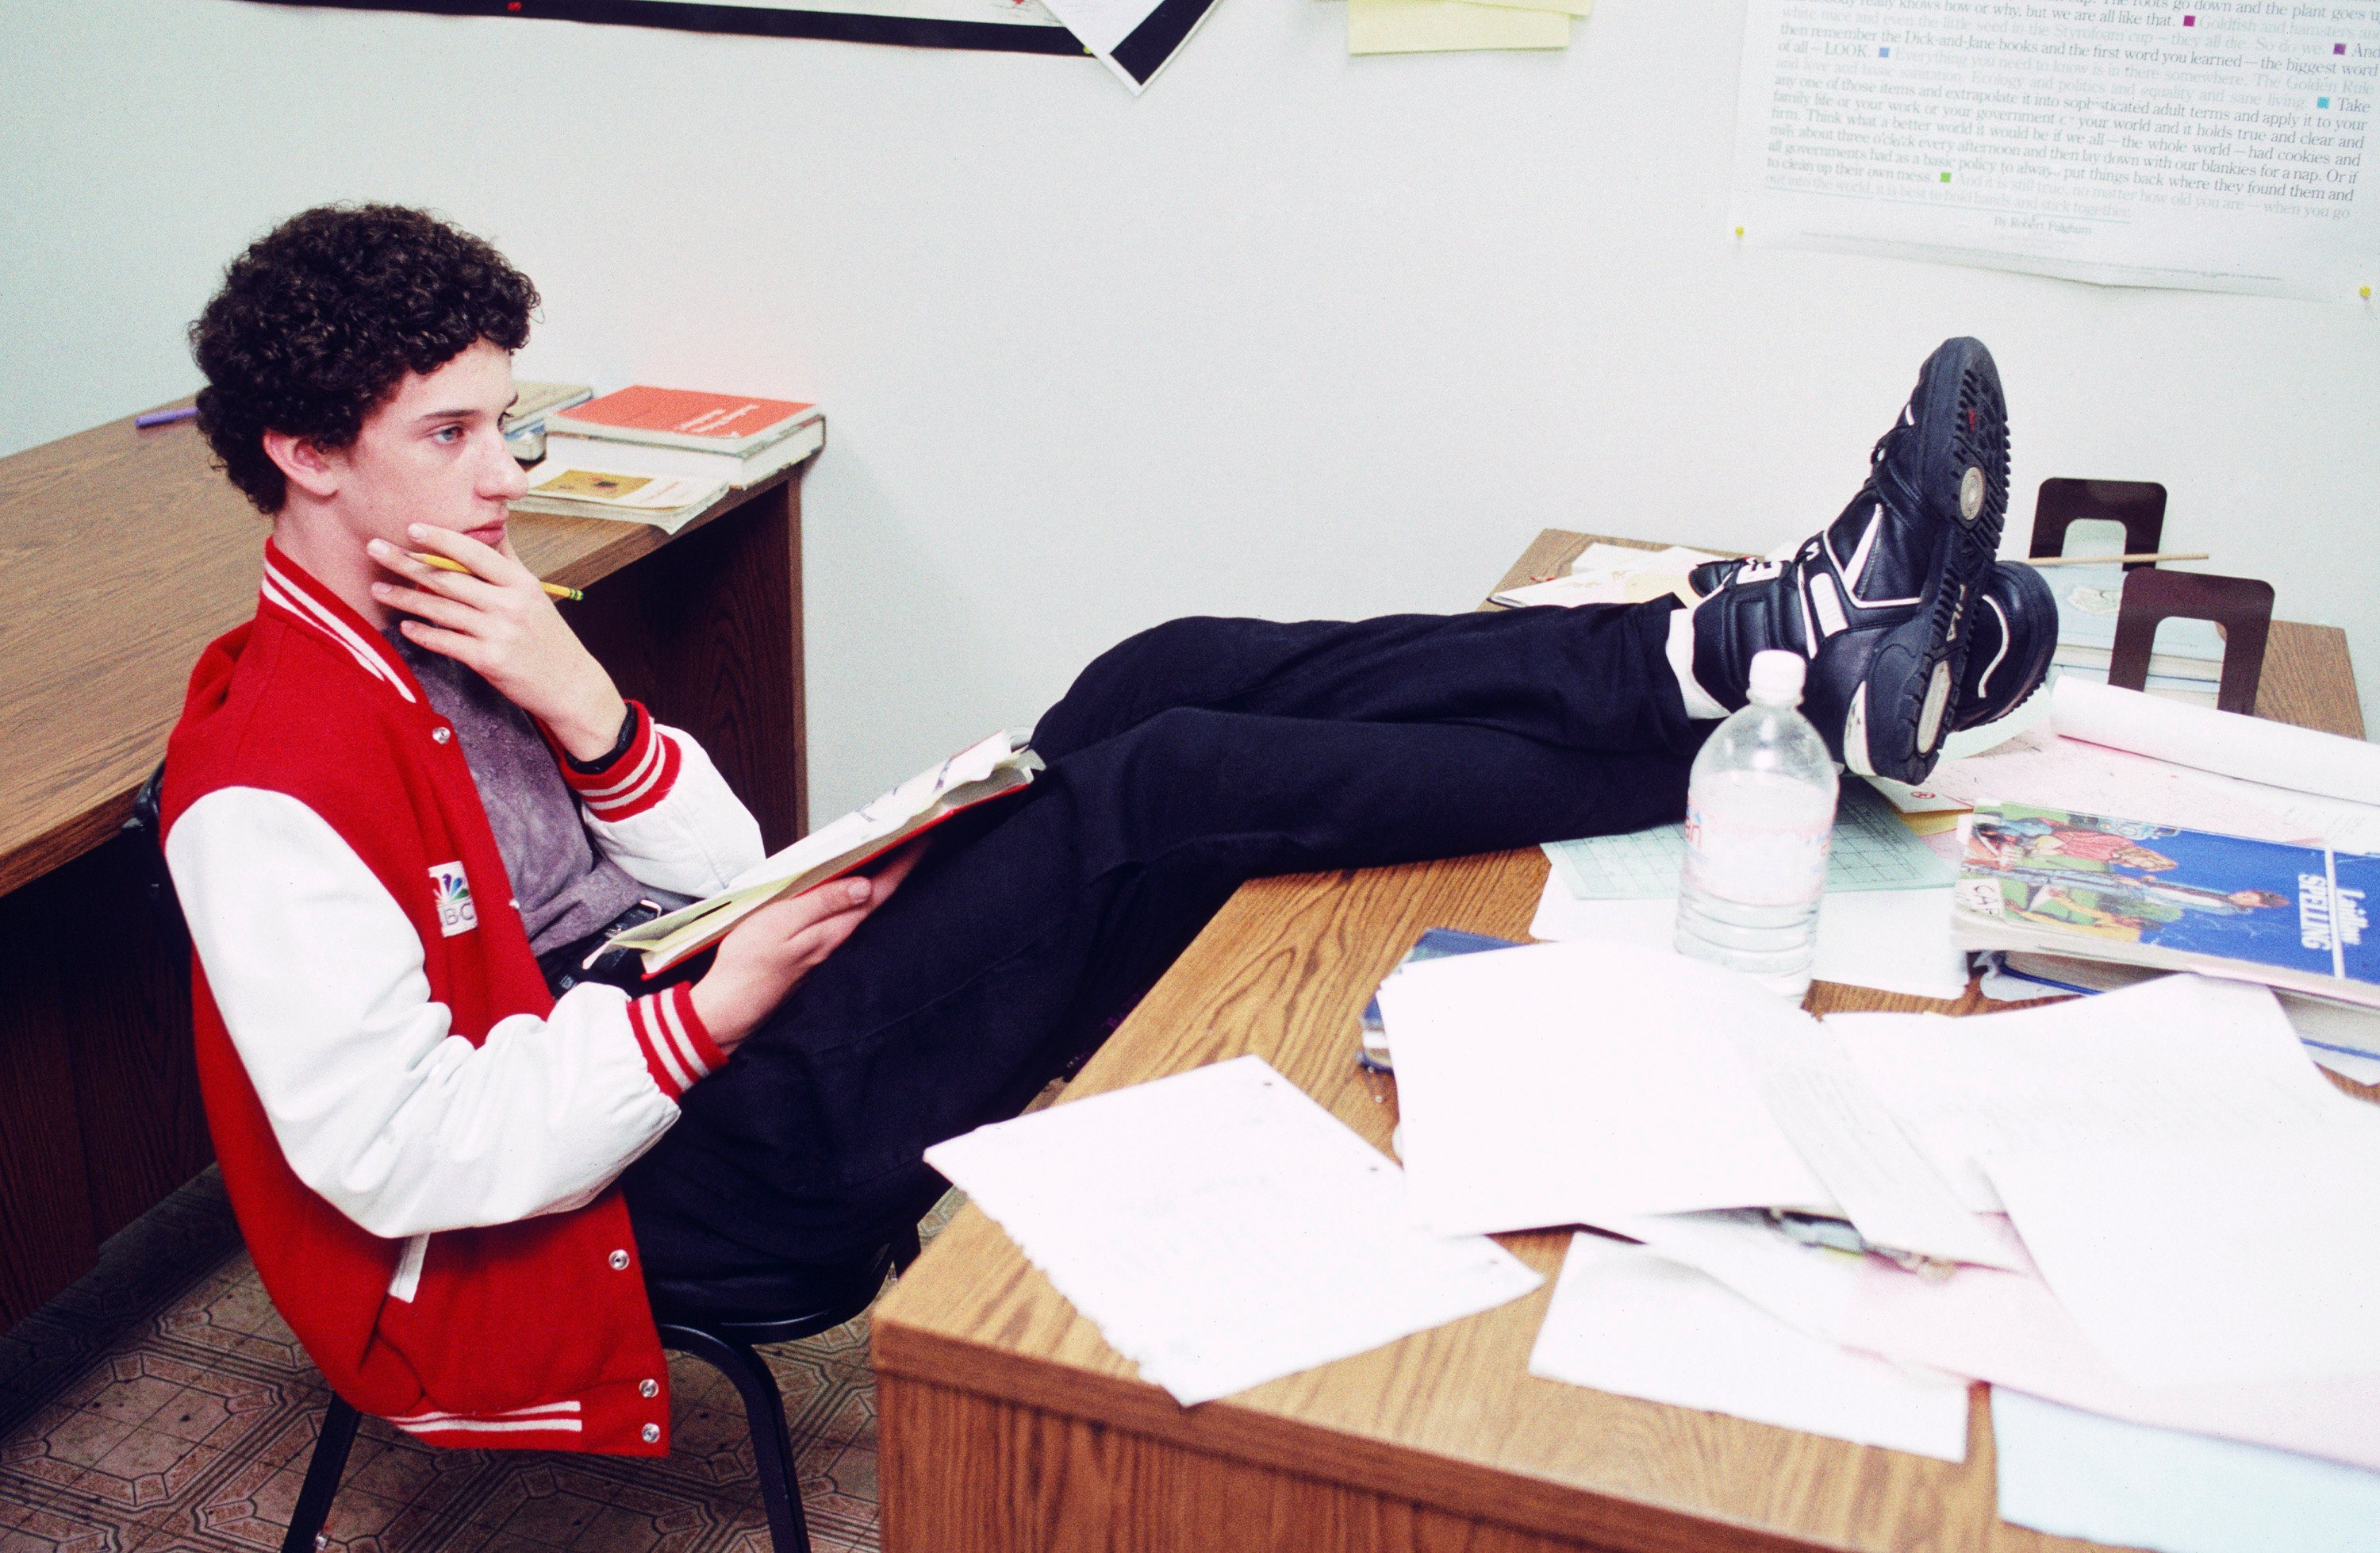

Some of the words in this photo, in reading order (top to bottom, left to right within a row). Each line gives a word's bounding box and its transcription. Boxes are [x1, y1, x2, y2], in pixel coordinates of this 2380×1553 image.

[1898, 0, 1940, 10] knows
[1944, 0, 1971, 13] how
[1974, 3, 1989, 14] or
[2025, 2, 2047, 18] but
[2052, 9, 2071, 20] we
[2074, 10, 2097, 21] are
[2098, 8, 2115, 22] all
[2117, 8, 2143, 25] like
[2171, 0, 2190, 13] go
[2194, 0, 2232, 12] down
[2235, 0, 2262, 13] and
[2265, 0, 2288, 16] the
[2291, 2, 2327, 21] plant
[2330, 8, 2367, 23] goes
[1779, 21, 1808, 37] then
[1811, 26, 1878, 41] remember
[1880, 29, 1901, 44] the
[1998, 37, 2038, 54] books
[2040, 40, 2066, 56] and
[2067, 42, 2090, 57] the
[2093, 43, 2121, 60] first
[2124, 47, 2159, 62] word
[2160, 52, 2186, 67] you
[2286, 56, 2338, 76] biggest
[2340, 61, 2379, 76] word
[1774, 75, 1795, 90] any
[1799, 77, 1821, 88] one
[1825, 75, 1839, 90] of
[1841, 77, 1875, 92] those
[1879, 80, 1915, 96] items
[1918, 84, 1942, 98] and
[1944, 88, 2018, 106] extrapolate
[2021, 91, 2032, 106] it
[2034, 92, 2059, 107] into
[2152, 101, 2186, 117] adult
[2190, 105, 2231, 121] terms
[2233, 107, 2259, 122] and
[2262, 110, 2299, 129] apply
[2303, 113, 2313, 127] it
[2317, 114, 2331, 128] to
[2334, 118, 2368, 133] your
[1837, 98, 1851, 108] or
[1854, 99, 1883, 112] your
[1887, 99, 1921, 113] work
[1924, 104, 1938, 114] or
[1941, 106, 1971, 119] your
[1975, 108, 2056, 124] government
[2077, 116, 2109, 130] your
[2113, 117, 2151, 132] world
[2154, 119, 2179, 134] and
[2182, 121, 2192, 135] it
[2196, 121, 2233, 138] holds
[2236, 126, 2267, 140] true
[2270, 128, 2297, 143] and
[2299, 129, 2335, 146] clear
[2338, 133, 2365, 148] and
[2335, 95, 2371, 113] Take
[1798, 125, 1834, 140] about
[1837, 127, 1870, 143] three
[1918, 138, 1955, 154] every
[1956, 138, 2020, 156] afternoon
[2022, 144, 2047, 159] and
[2049, 145, 2079, 161] then
[2081, 148, 2101, 167] lay
[2103, 149, 2140, 167] down
[2143, 154, 2172, 169] with
[2174, 160, 2198, 171] our
[2201, 157, 2257, 176] blankies
[2259, 162, 2280, 178] for
[2282, 168, 2291, 179] a
[2325, 167, 2346, 183] Or
[2347, 169, 2359, 184] if
[1805, 108, 1842, 124] Think
[1846, 112, 1876, 127] what
[1880, 118, 1888, 128] a
[1891, 114, 1932, 132] better
[1936, 120, 1973, 135] world
[1976, 122, 1985, 136] it
[1990, 125, 2029, 139] would
[2032, 125, 2048, 140] be
[2052, 128, 2063, 142] if
[2066, 133, 2084, 144] we
[2147, 136, 2187, 152] whole
[2277, 147, 2331, 163] cookies
[2335, 151, 2362, 166] and
[1785, 143, 1867, 159] governments
[1869, 146, 1894, 161] had
[1895, 152, 1909, 163] as
[1912, 154, 1921, 164] a
[1922, 151, 1955, 167] basic
[1958, 156, 1996, 175] policy
[2000, 160, 2013, 172] to
[2063, 166, 2086, 181] put
[2089, 166, 2130, 186] things
[2132, 169, 2165, 186] back
[2167, 173, 2210, 190] where
[2213, 176, 2244, 196] they
[2247, 179, 2286, 196] found
[2289, 183, 2326, 199] them
[2328, 186, 2355, 201] and
[444, 903, 474, 925] BC
[2297, 874, 2332, 950] SPELLING
